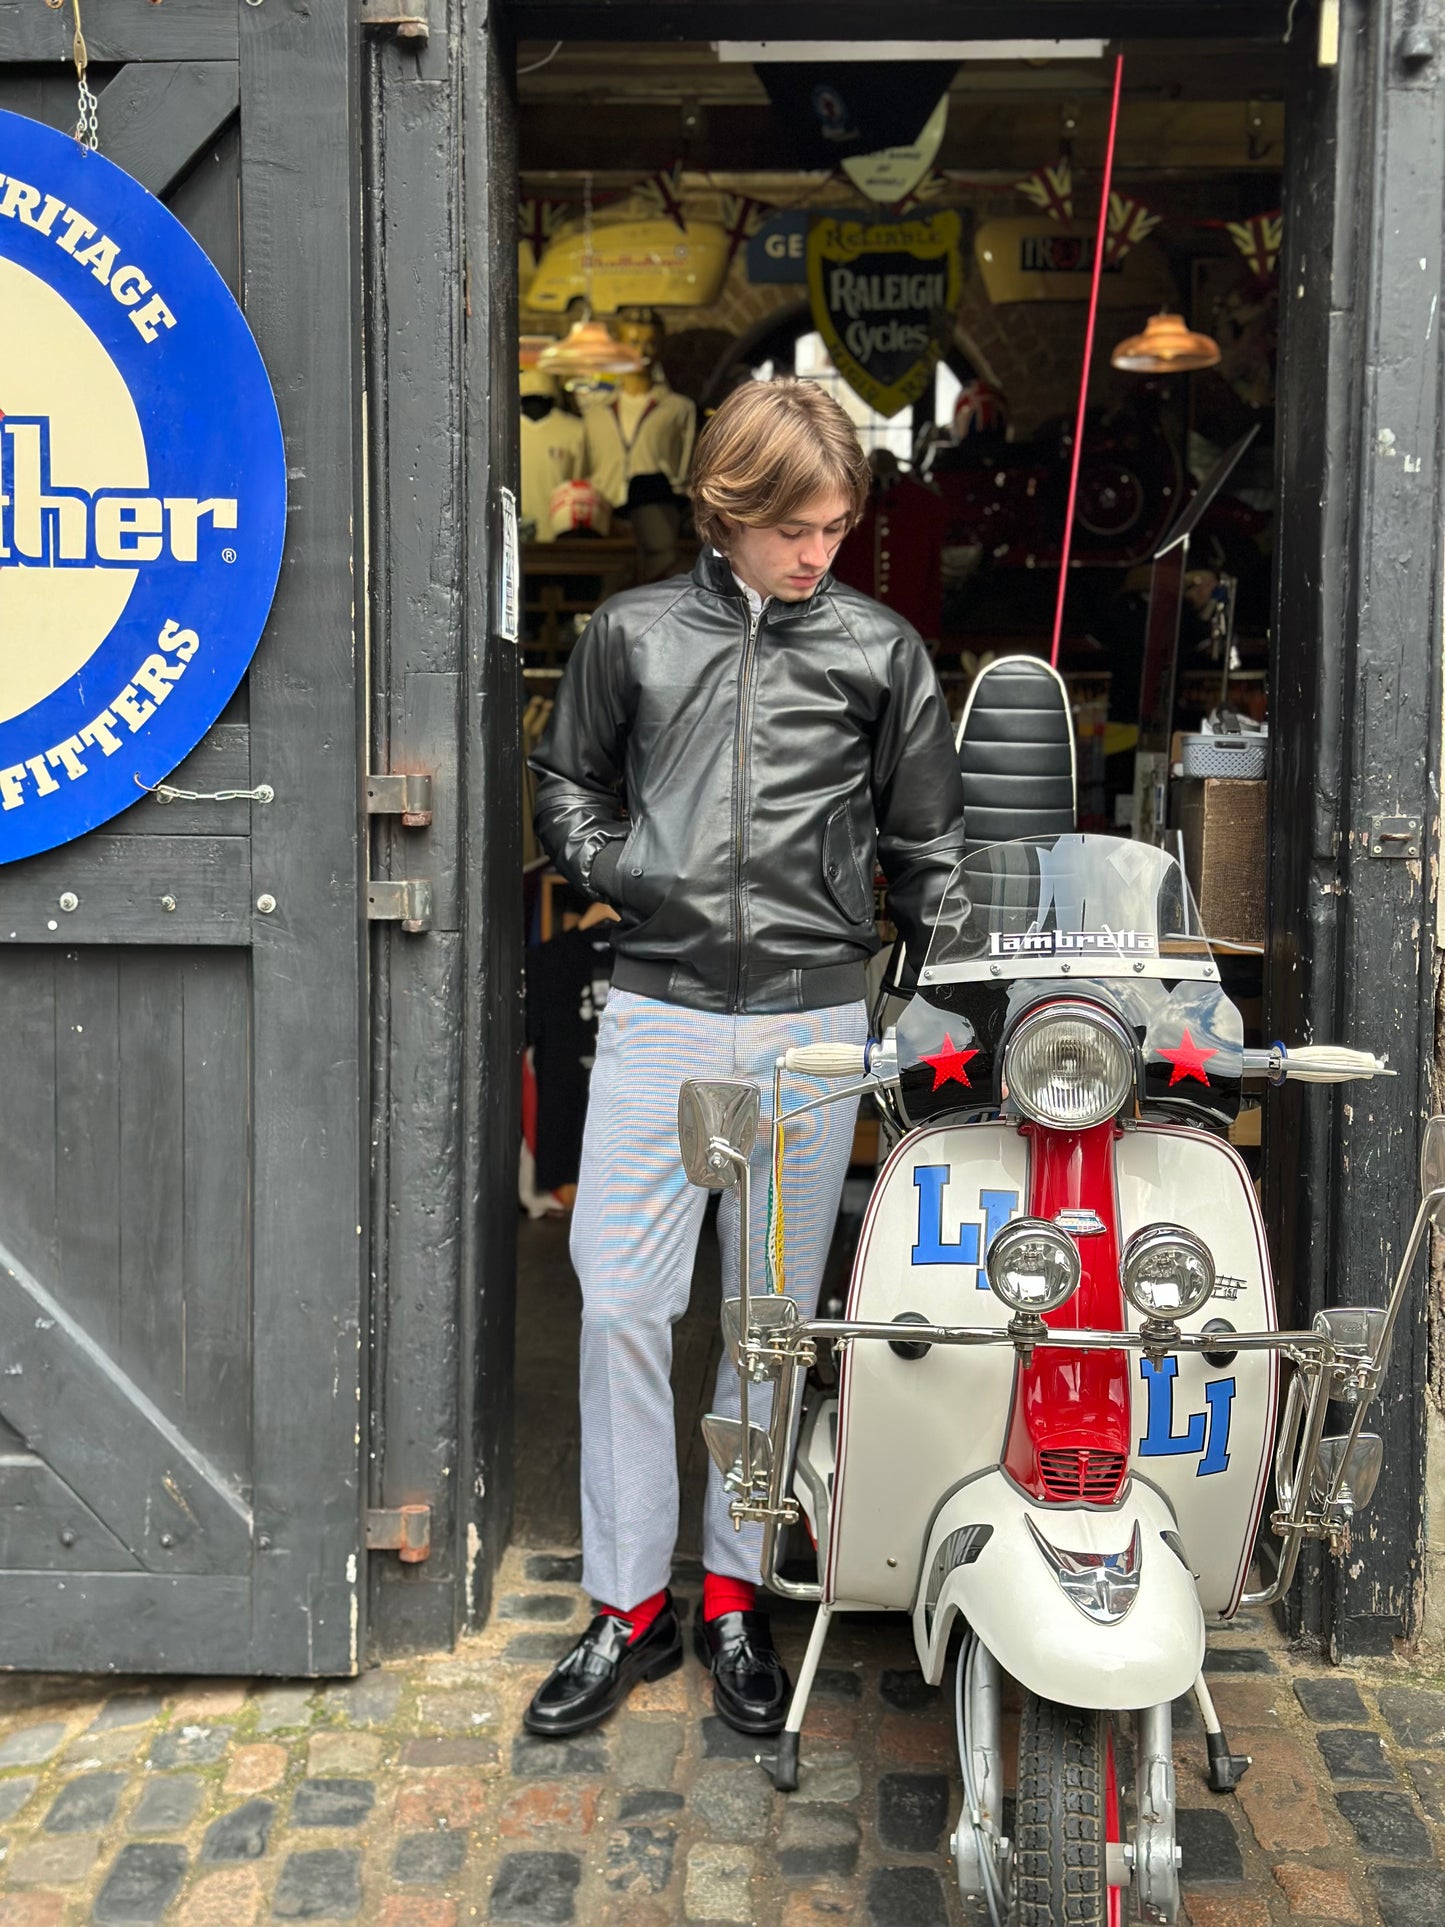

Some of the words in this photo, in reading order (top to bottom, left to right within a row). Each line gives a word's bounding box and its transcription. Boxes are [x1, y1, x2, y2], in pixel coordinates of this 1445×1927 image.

[0, 173, 177, 344] RITAGE
[830, 268, 944, 319] RALEIGH
[845, 320, 930, 363] Cycles
[0, 619, 200, 811] FITTERS
[989, 929, 1155, 957] Lambretta
[1138, 1355, 1237, 1477] LI
